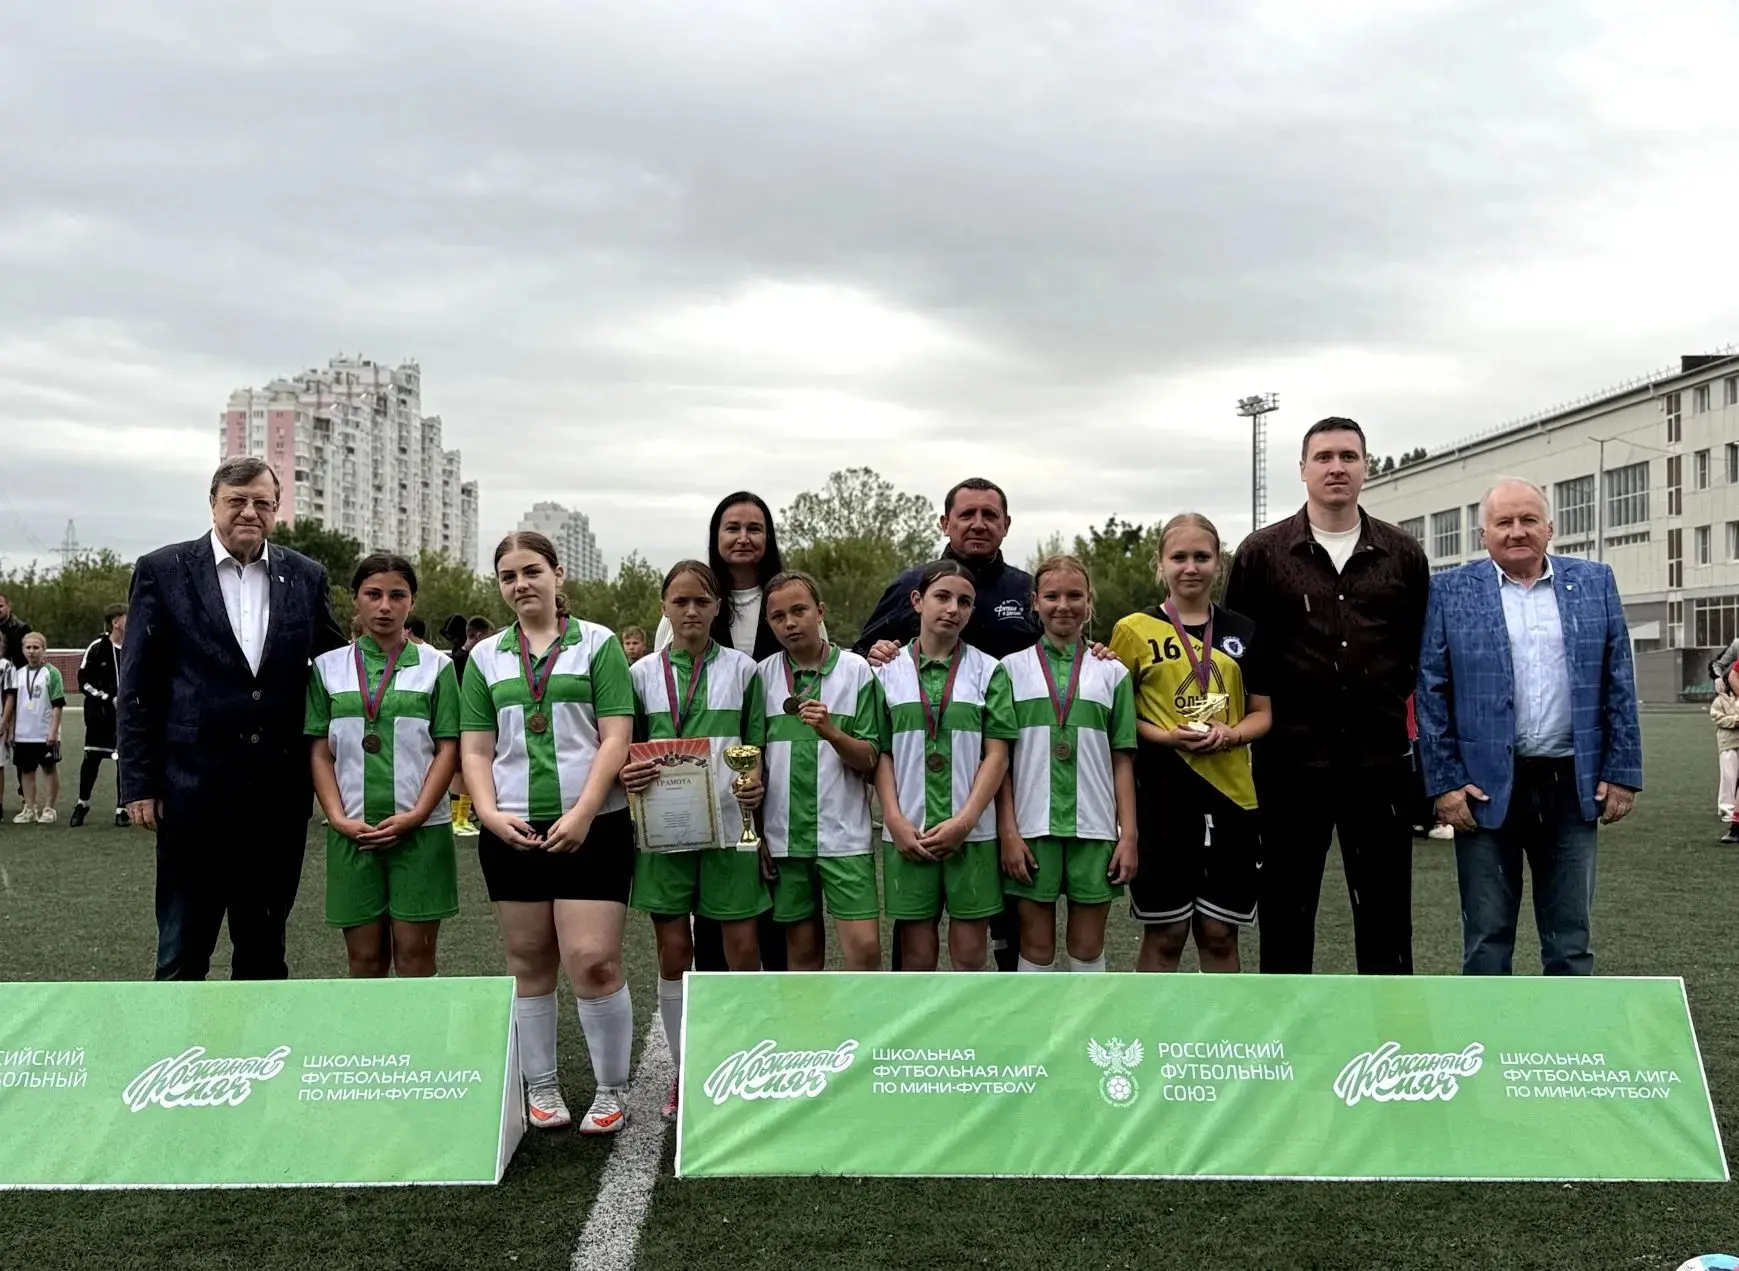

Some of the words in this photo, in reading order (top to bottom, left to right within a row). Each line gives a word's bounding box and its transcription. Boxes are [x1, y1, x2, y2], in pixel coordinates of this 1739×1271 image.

[1147, 636, 1181, 665] 16
[872, 1048, 976, 1061] ШКОЛЬНАЯ
[1158, 1039, 1285, 1059] РОССИЙСКИЙ
[302, 1054, 411, 1068] ШКОЛЬНАЯ
[1499, 1052, 1606, 1066] ШКОЛЬНАЯ
[0, 1067, 88, 1088] ОЛЬНЫЙ
[301, 1070, 431, 1085] ФУТБОЛЬНАЯ
[434, 1069, 482, 1084] ЛИГА
[872, 1064, 999, 1078] ФУТБОЛЬНАЯ
[1002, 1065, 1049, 1078] ЛИГА
[1160, 1061, 1294, 1081] ФУТБОЛЬНЫЙ
[1503, 1069, 1631, 1083] ФУТБОЛЬНАЯ
[1634, 1070, 1682, 1084] ЛИГА
[298, 1088, 324, 1101] ПО
[326, 1087, 468, 1101] МИНИ-ФУТБОЛУ
[872, 1082, 897, 1094] ПО
[900, 1081, 1037, 1094] МИНИ-ФУТБОЛУ
[1162, 1084, 1217, 1102] СОЮЗ
[1506, 1086, 1531, 1098] ПО
[1533, 1086, 1671, 1099] МИНИ-ФУТБОЛУ
